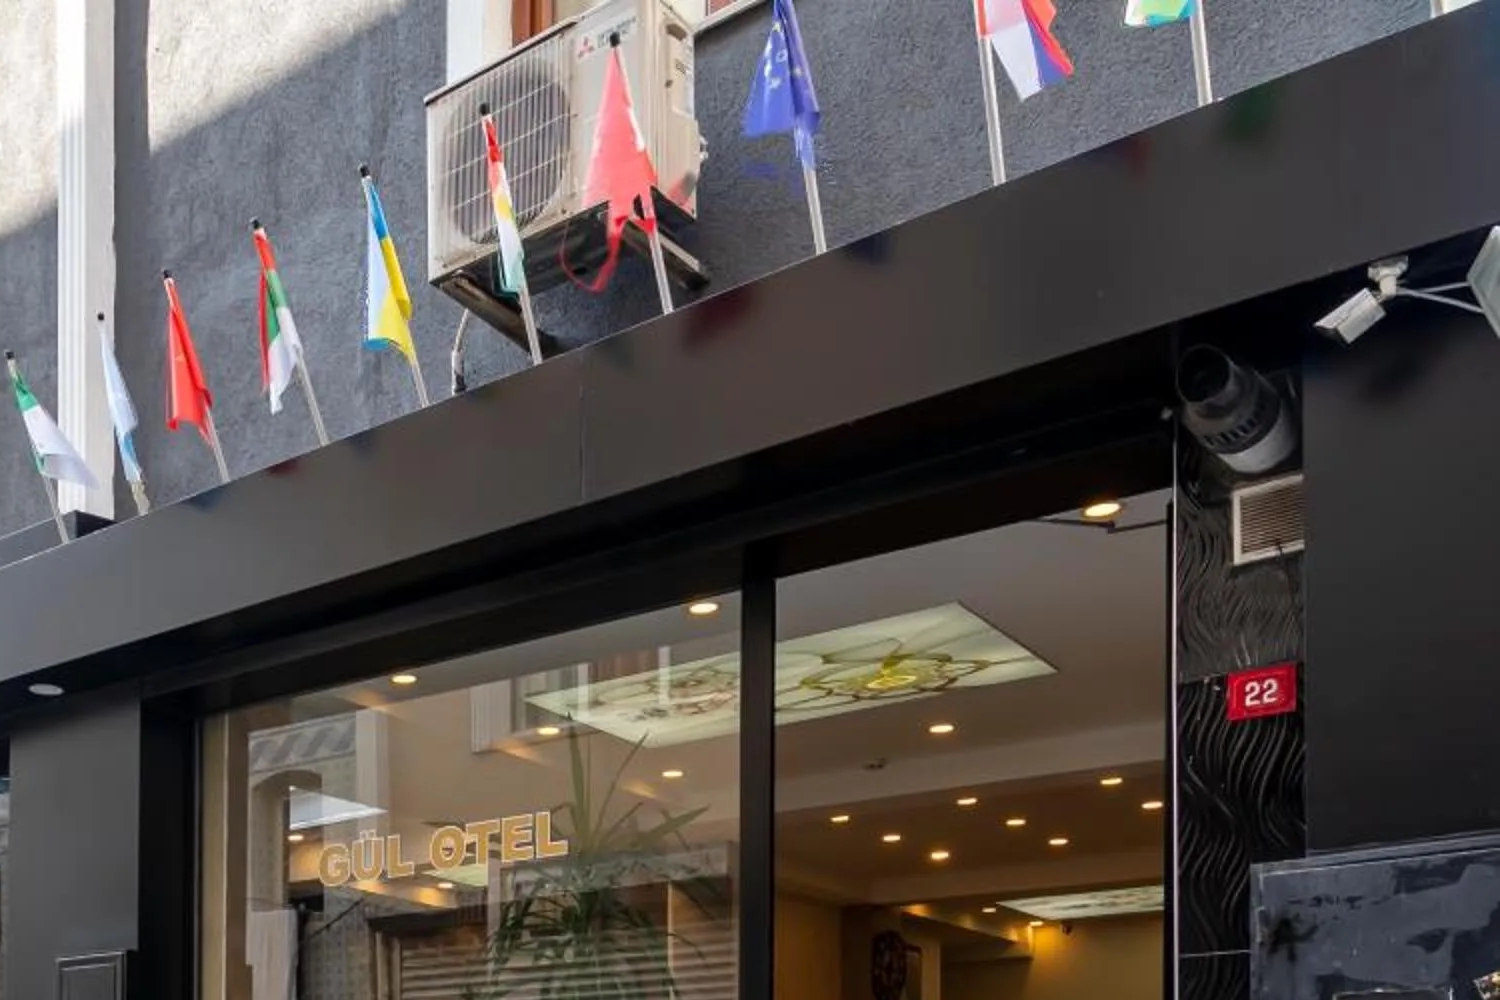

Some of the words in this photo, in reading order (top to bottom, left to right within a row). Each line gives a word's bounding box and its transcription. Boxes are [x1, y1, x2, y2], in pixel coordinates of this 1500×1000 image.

[1244, 678, 1279, 707] 22
[318, 829, 415, 887] GÜL
[430, 811, 569, 871] OTEL
